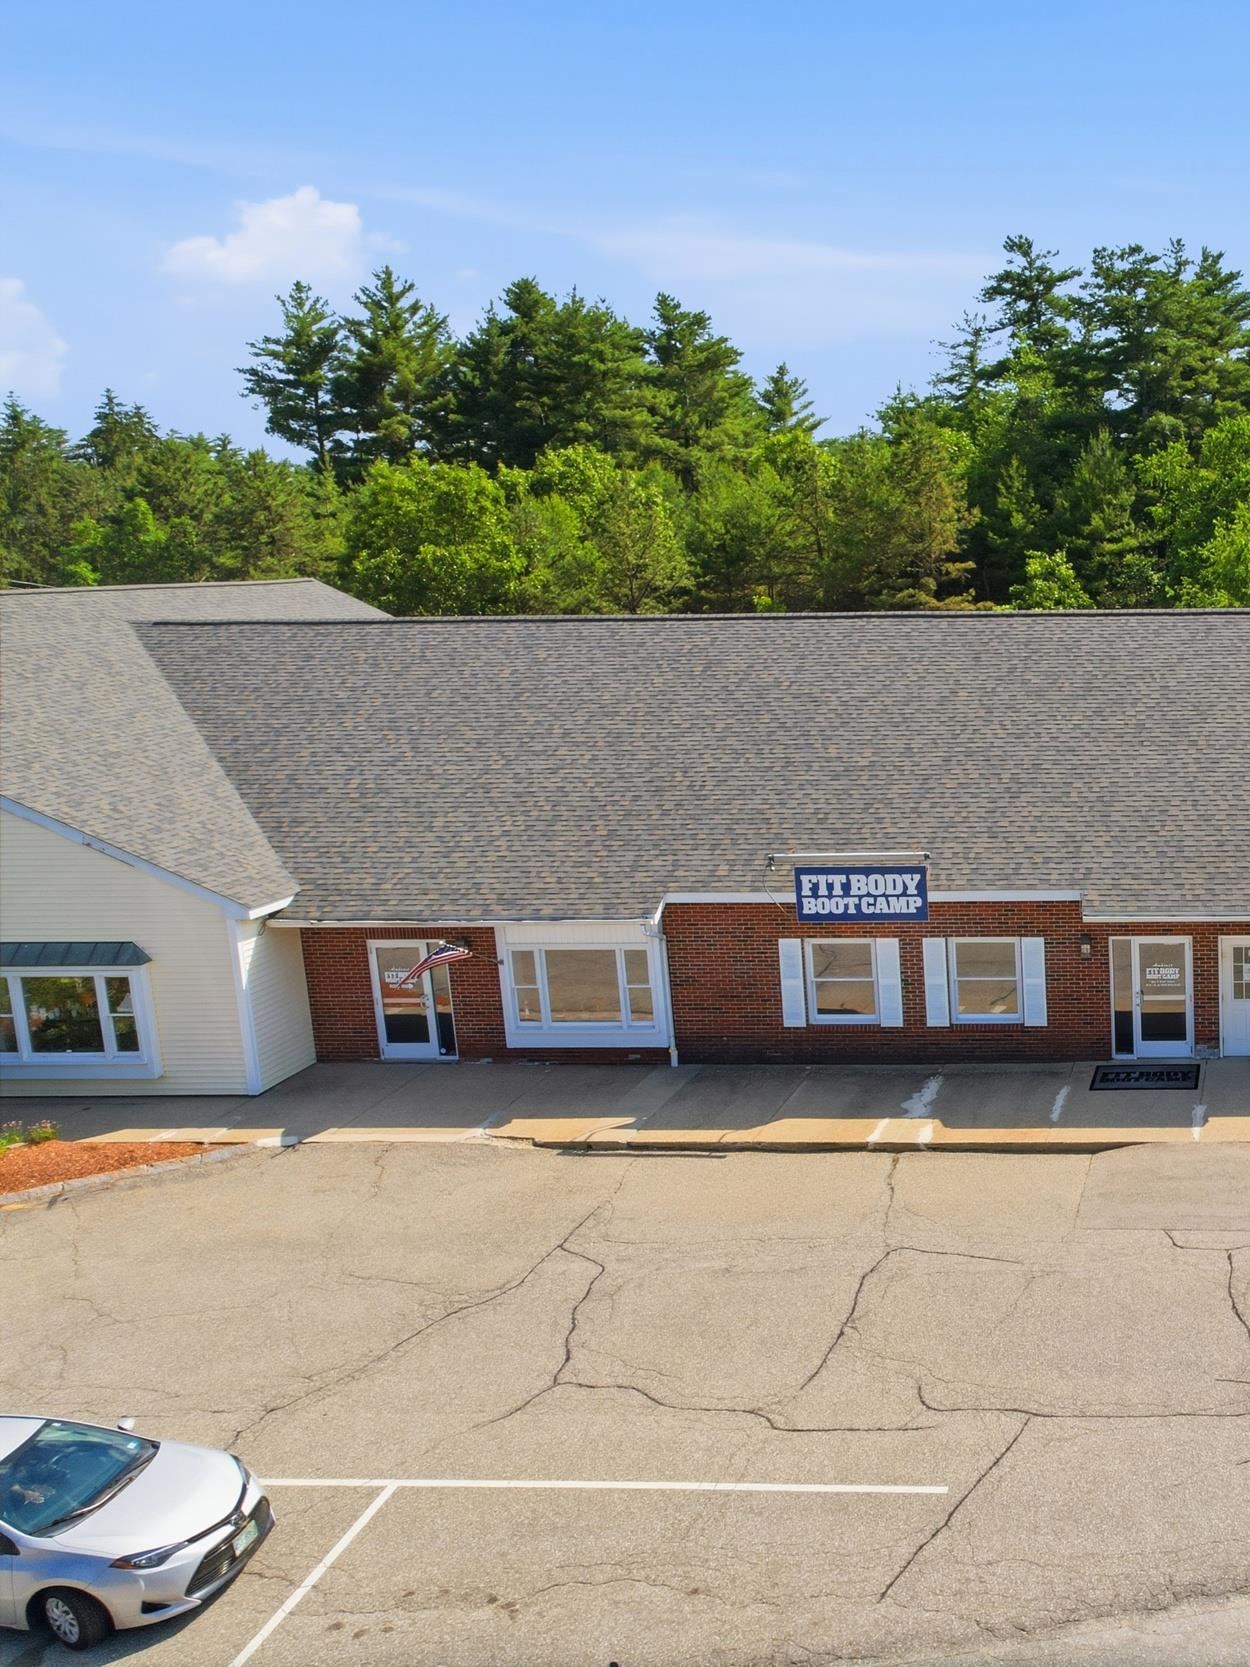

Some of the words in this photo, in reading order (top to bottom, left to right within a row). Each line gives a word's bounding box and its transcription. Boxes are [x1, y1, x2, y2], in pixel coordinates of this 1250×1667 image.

[800, 874, 846, 896] FIT
[848, 874, 921, 896] BODY
[801, 896, 859, 914] BOOT
[861, 896, 922, 914] CAMP
